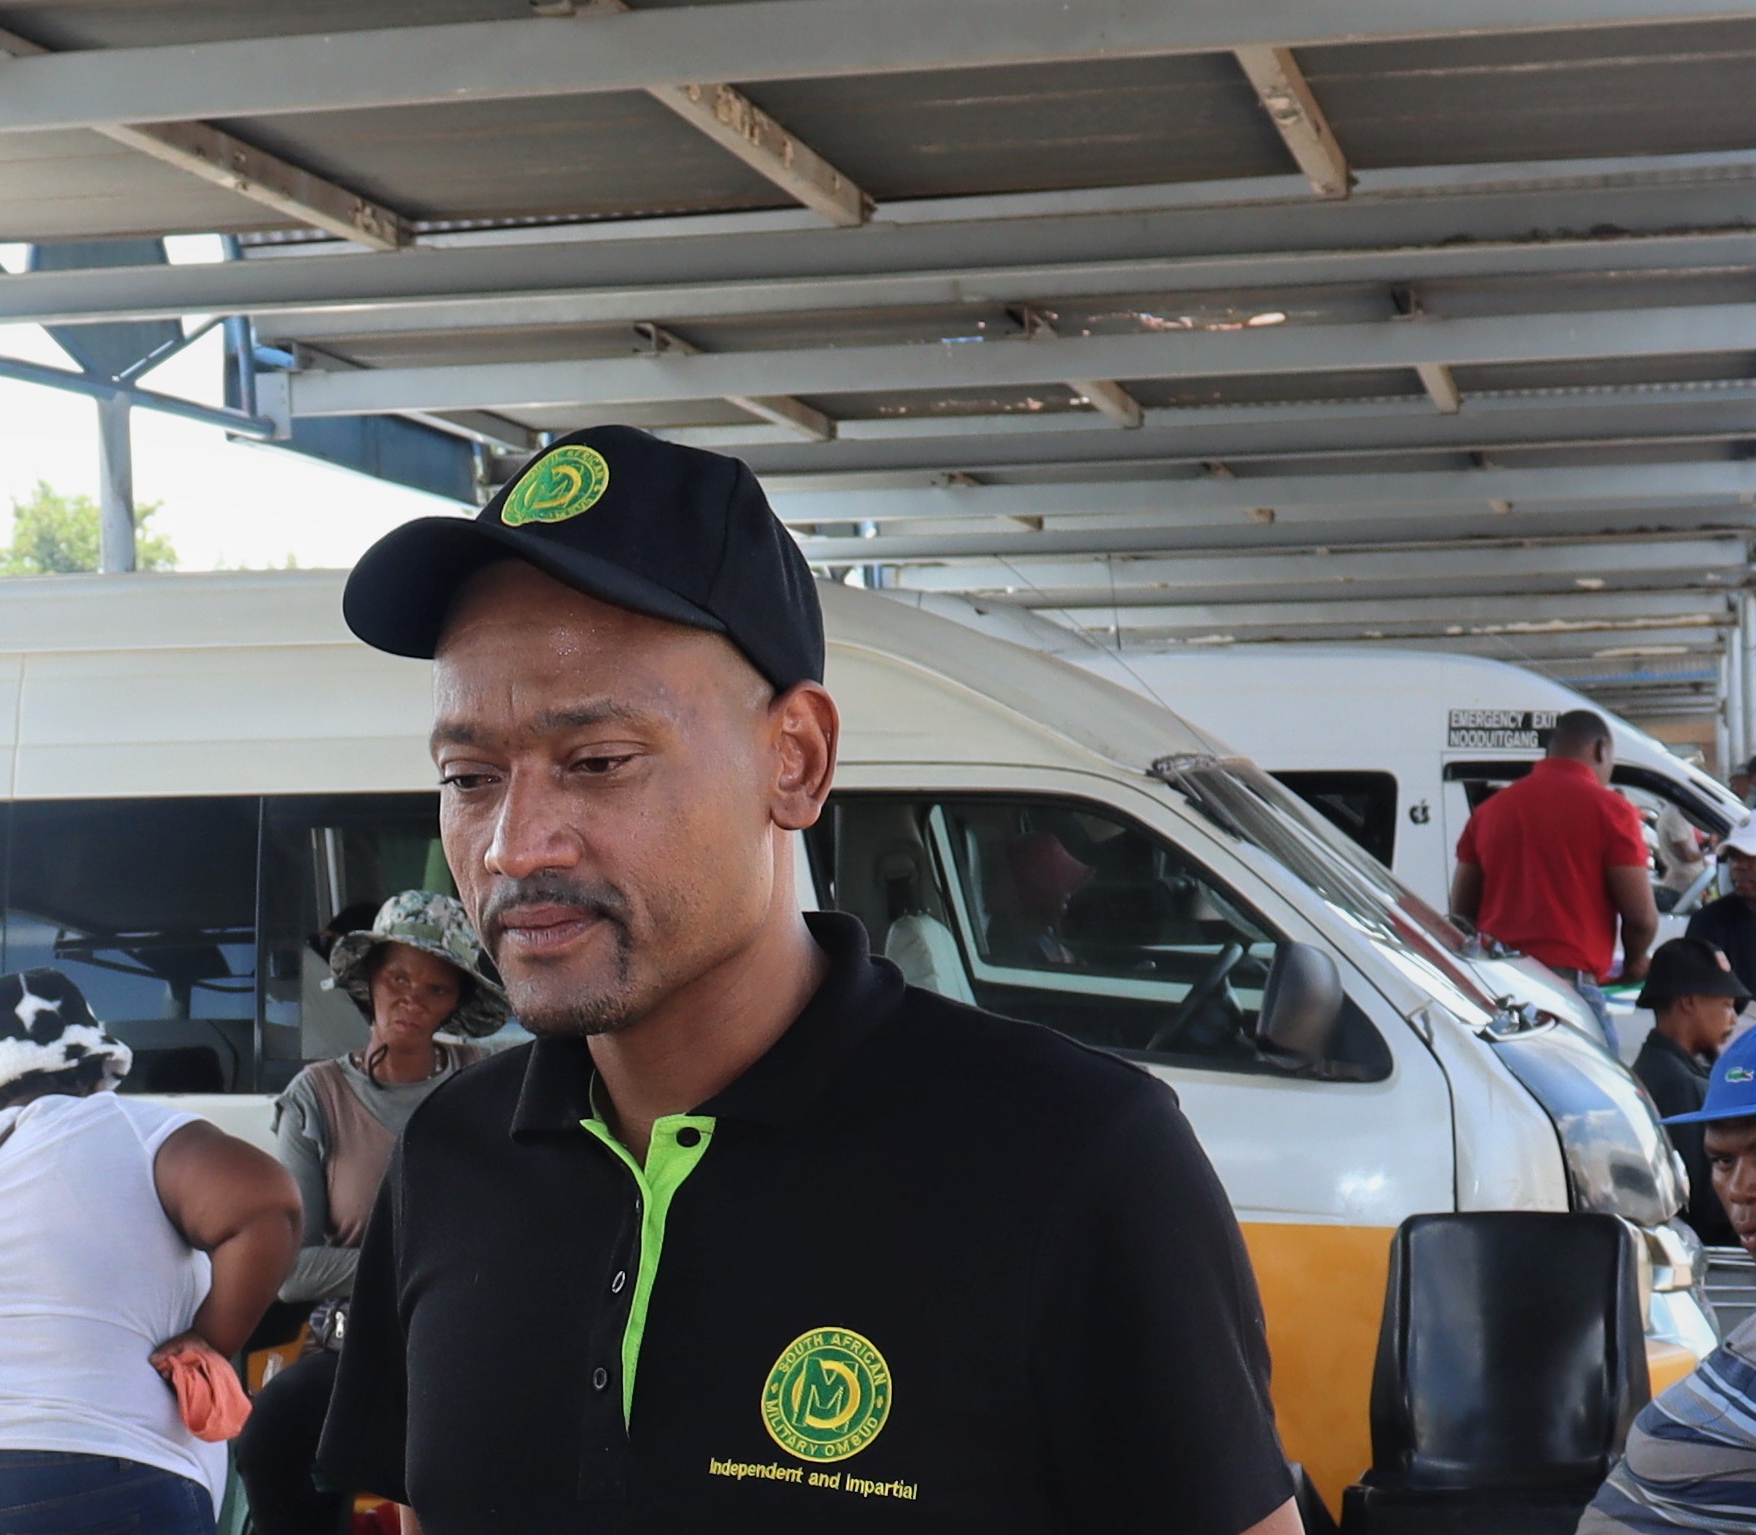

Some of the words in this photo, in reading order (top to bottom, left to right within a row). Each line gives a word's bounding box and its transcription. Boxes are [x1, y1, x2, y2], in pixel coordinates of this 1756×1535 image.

[1449, 729, 1539, 748] NOODUITGANG
[1450, 710, 1525, 728] EMERGENCY
[1532, 711, 1559, 729] EXIT
[779, 1333, 824, 1373] SOUTH
[831, 1333, 887, 1386] AFRICAN
[765, 1400, 818, 1456] MILITARY
[825, 1417, 878, 1457] OMBUD
[709, 1457, 803, 1483] Independent
[808, 1472, 841, 1490] and
[845, 1473, 918, 1500] Impartial
